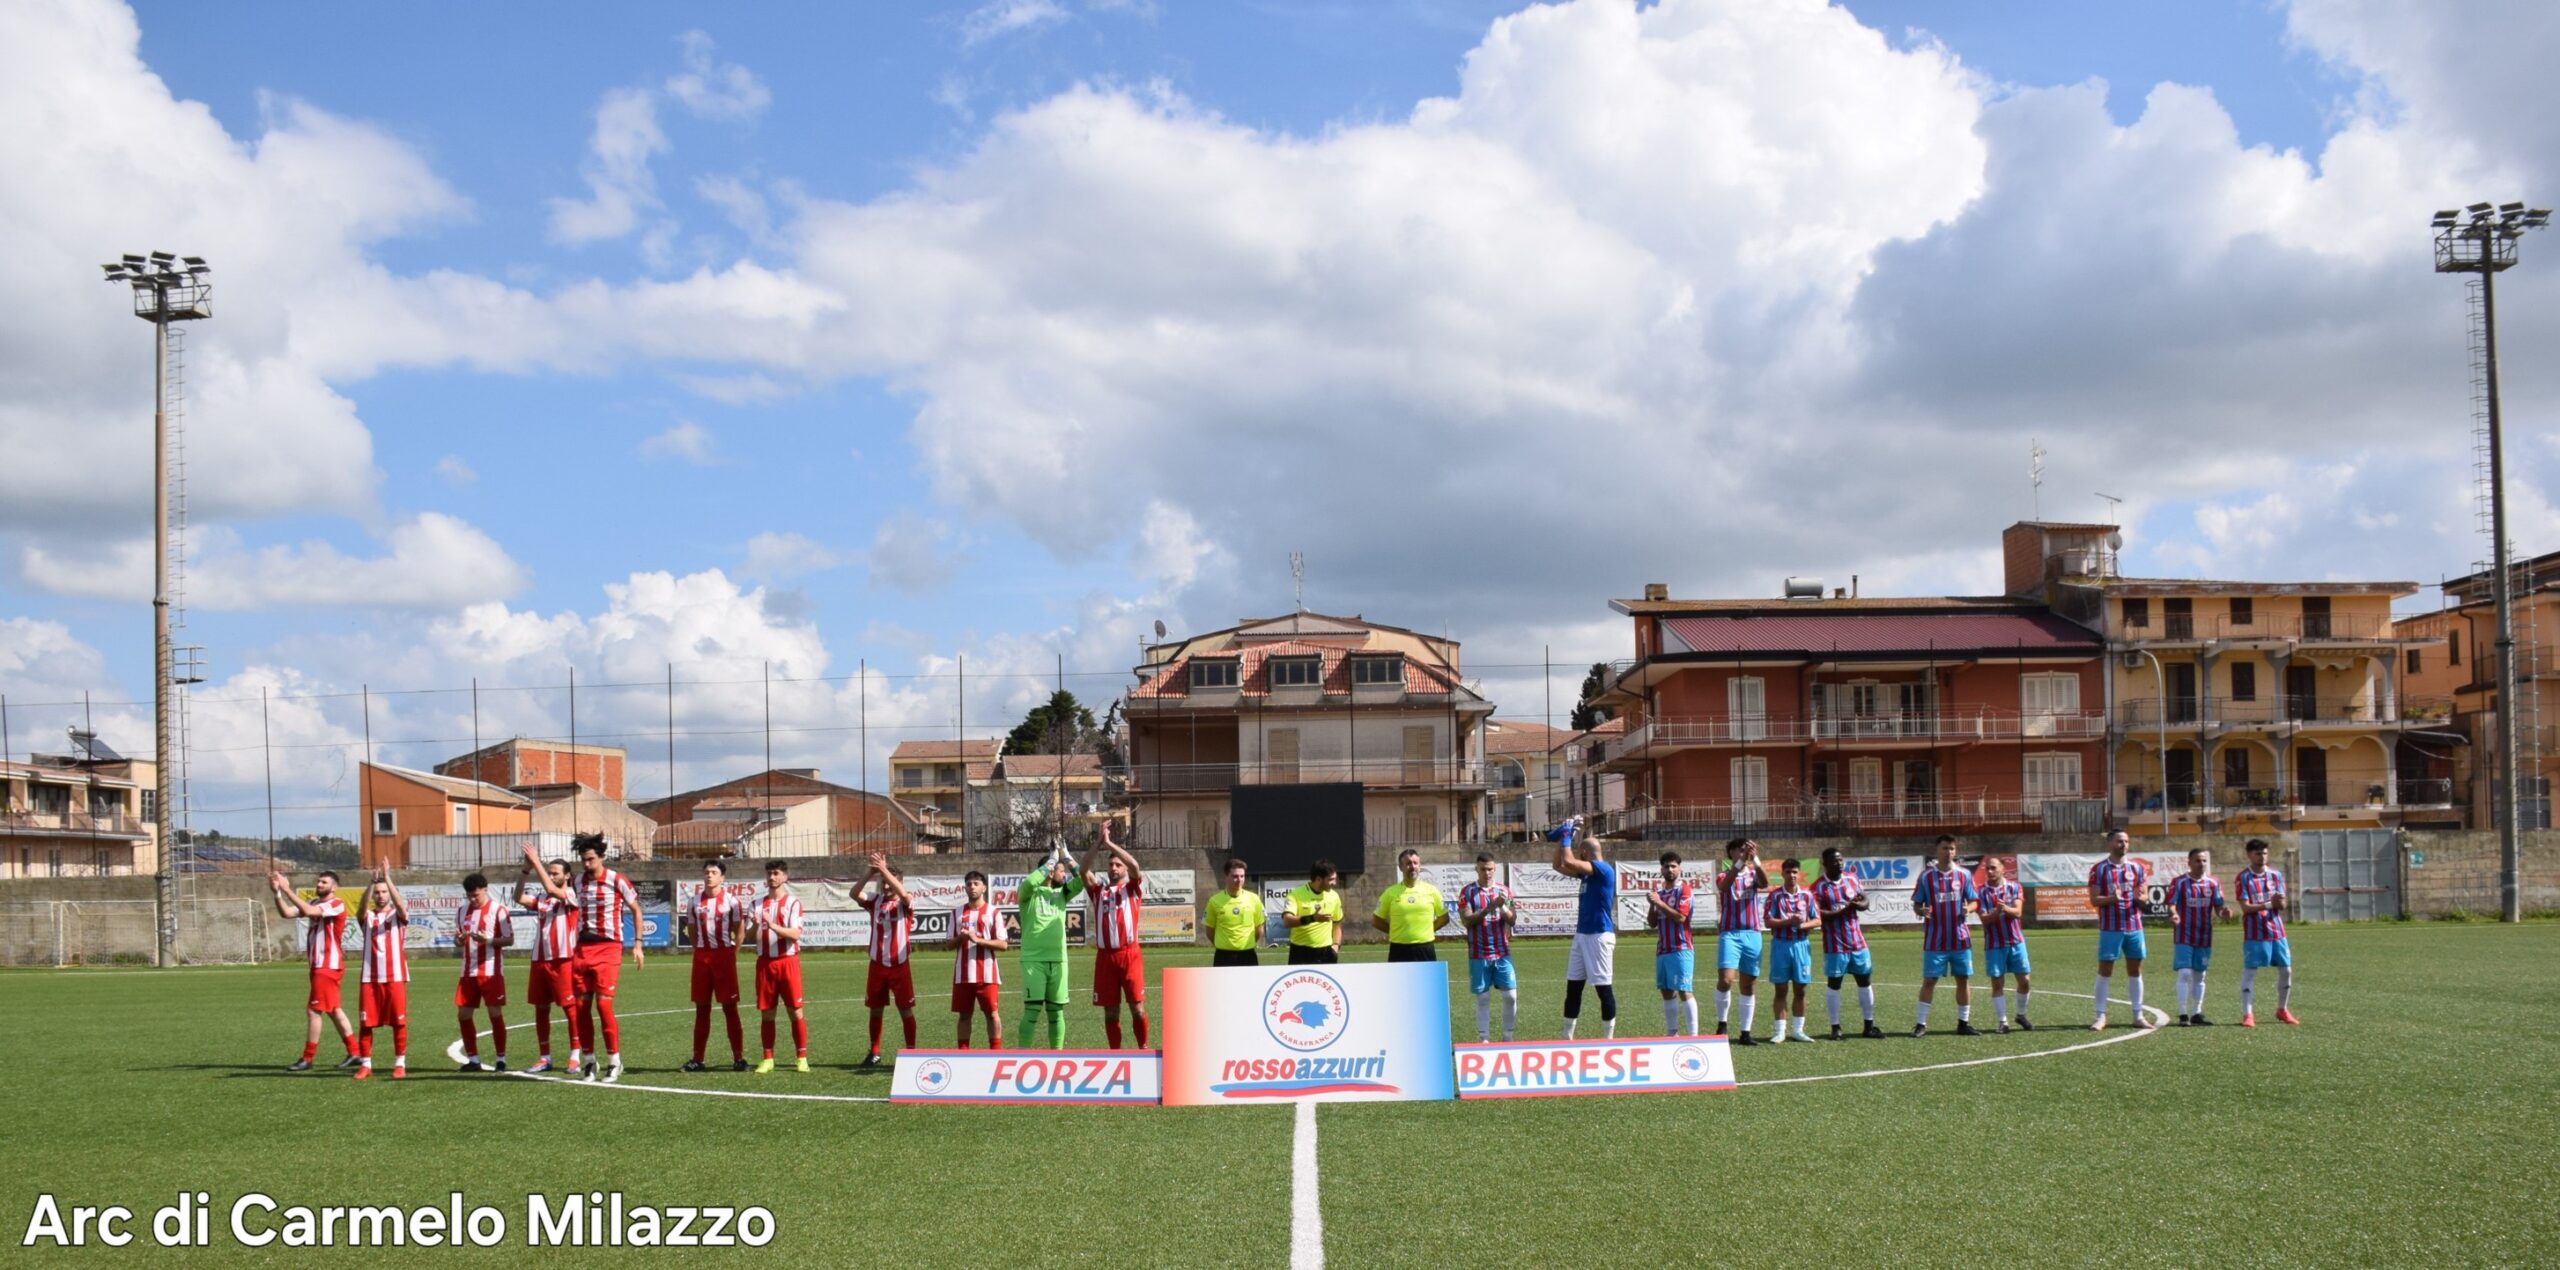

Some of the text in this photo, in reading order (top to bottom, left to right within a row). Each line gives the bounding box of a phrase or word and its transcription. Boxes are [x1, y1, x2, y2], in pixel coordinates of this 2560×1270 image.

[1844, 858, 1909, 880] AVIS
[1514, 900, 1574, 910] Strazzanti
[1284, 975, 1334, 994] BARRESE
[1278, 1031, 1335, 1047] BARRAFRANCA
[1222, 1049, 1386, 1081] rossoazzurri
[1459, 1047, 1651, 1089] BARRESE
[988, 1059, 1132, 1094] FORZA
